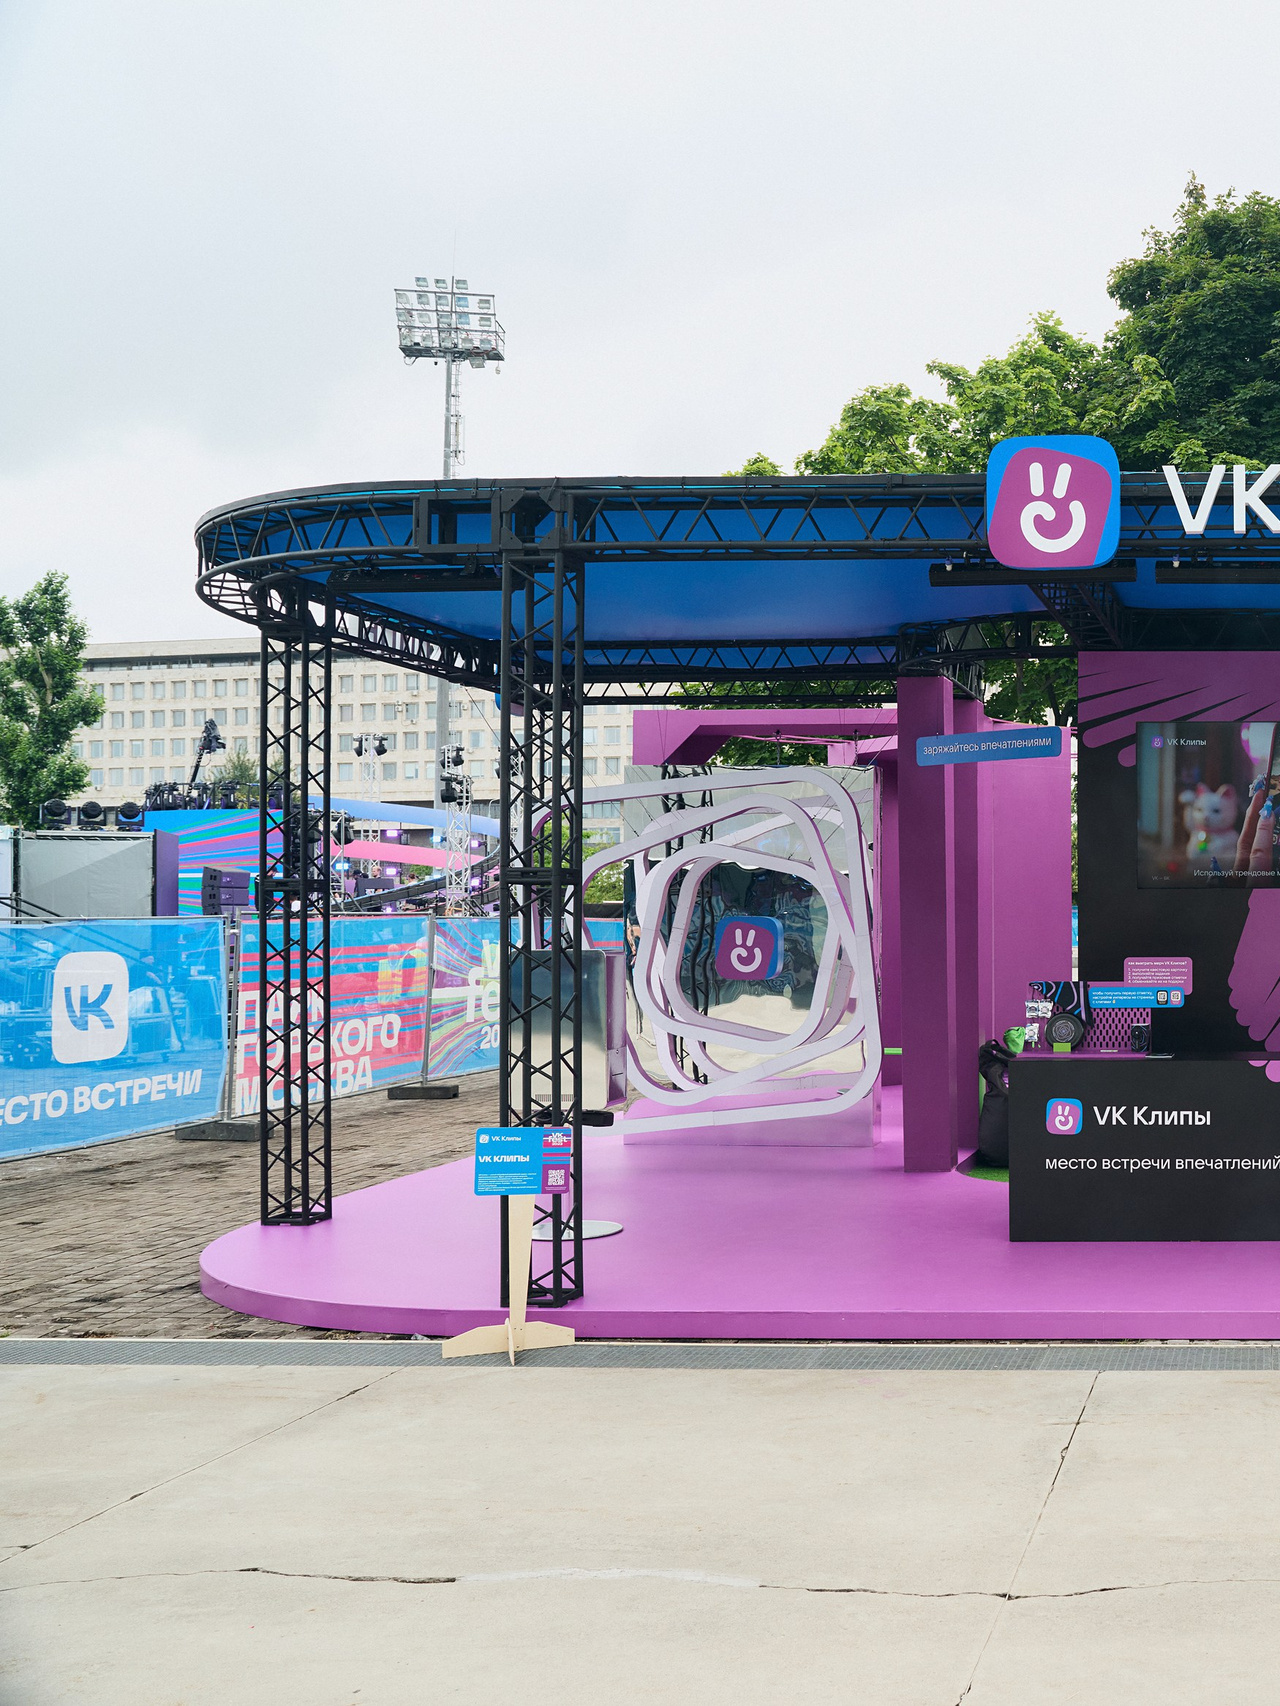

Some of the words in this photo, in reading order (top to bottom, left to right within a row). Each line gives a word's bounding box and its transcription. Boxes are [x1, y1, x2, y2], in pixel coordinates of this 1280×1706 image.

[923, 741, 979, 757] заряжайтесь
[980, 737, 1052, 751] впечатлениями
[1167, 738, 1179, 746] VK
[1180, 738, 1207, 746] Клипы
[1193, 868, 1234, 878] Используй
[1235, 870, 1276, 878] трендовые
[480, 1024, 500, 1049] 20
[74, 1069, 203, 1114] ВСТРЕЧИ
[1093, 1105, 1128, 1126] VK
[1133, 1105, 1211, 1126] Клипы
[1045, 1158, 1097, 1170] место
[1102, 1158, 1171, 1173] встречи
